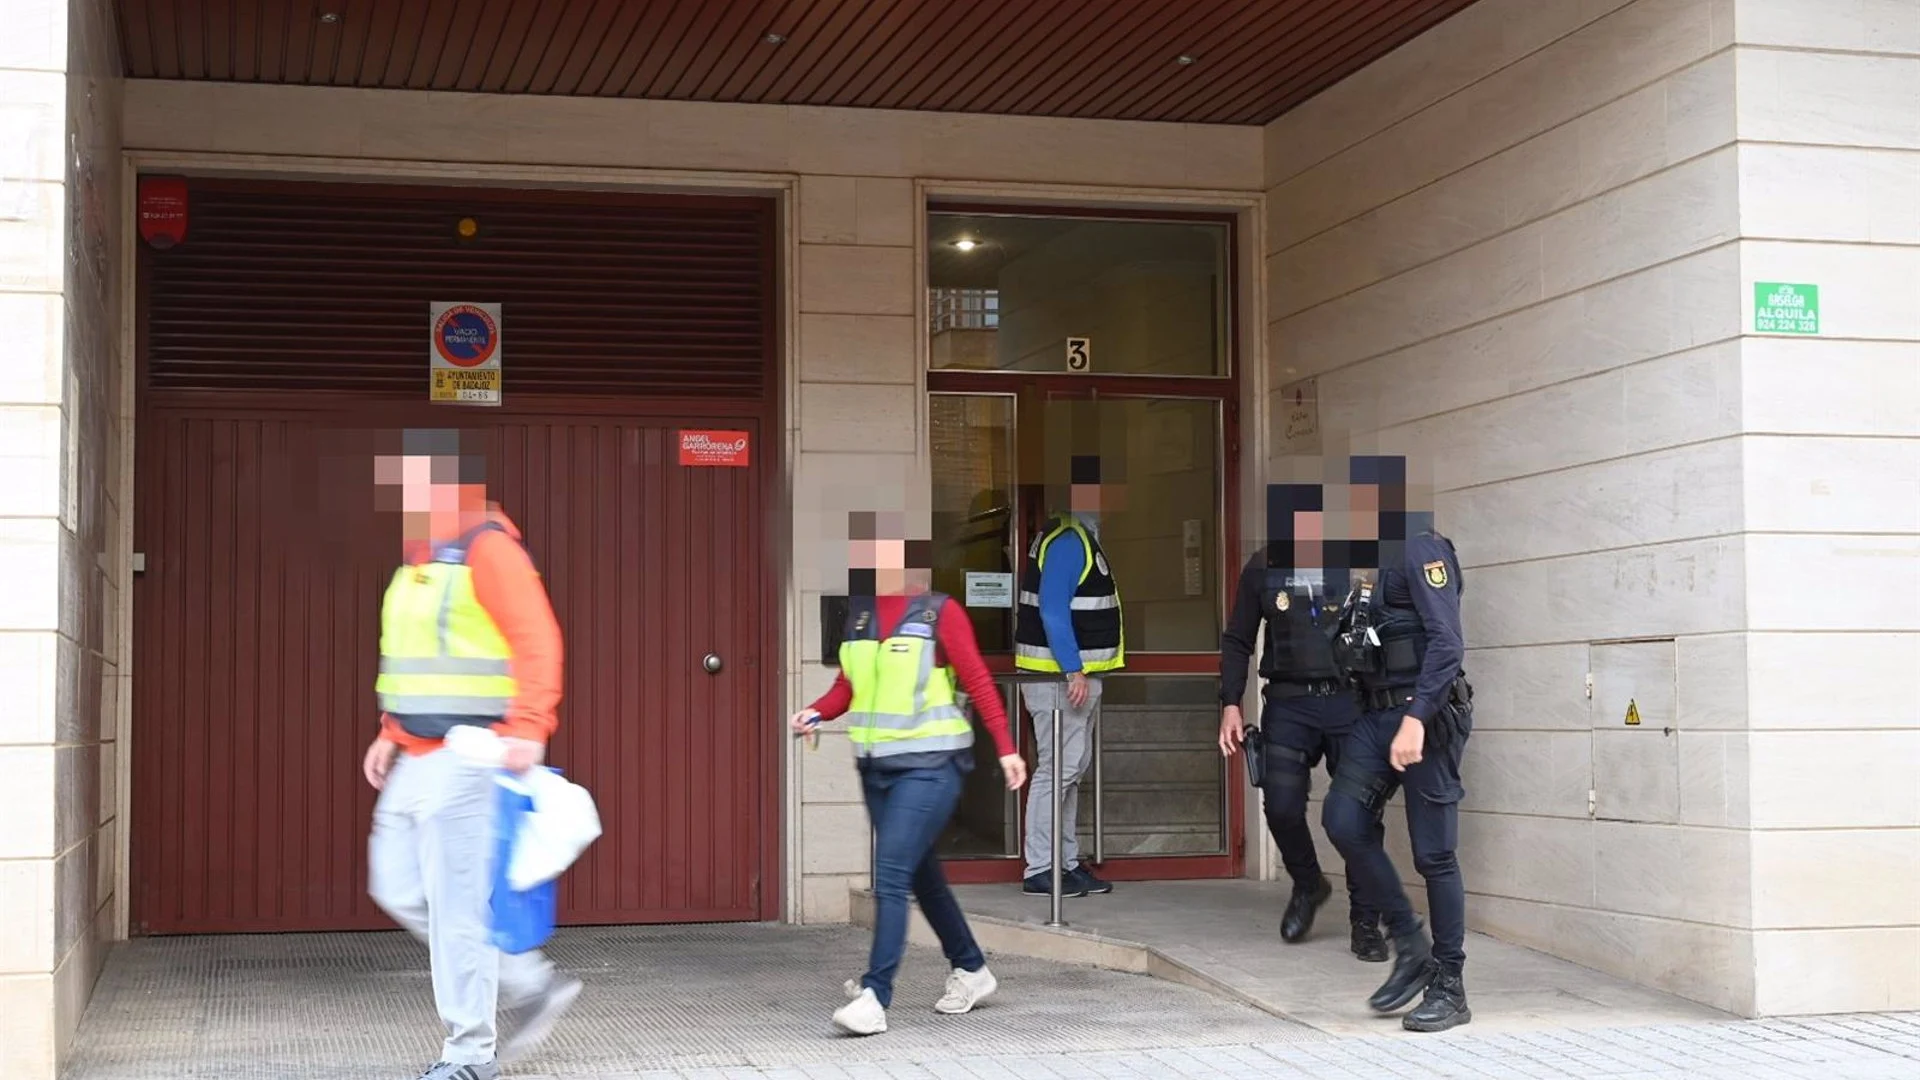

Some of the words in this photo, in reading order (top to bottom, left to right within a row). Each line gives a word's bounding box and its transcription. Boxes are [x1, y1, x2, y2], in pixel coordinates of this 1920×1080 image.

[1757, 307, 1815, 320] ALQUILA
[1757, 318, 1775, 330] 924
[1777, 319, 1795, 331] 224
[1069, 340, 1087, 370] 3
[447, 370, 495, 380] AYUNTAMIENTO
[452, 380, 461, 390] DE
